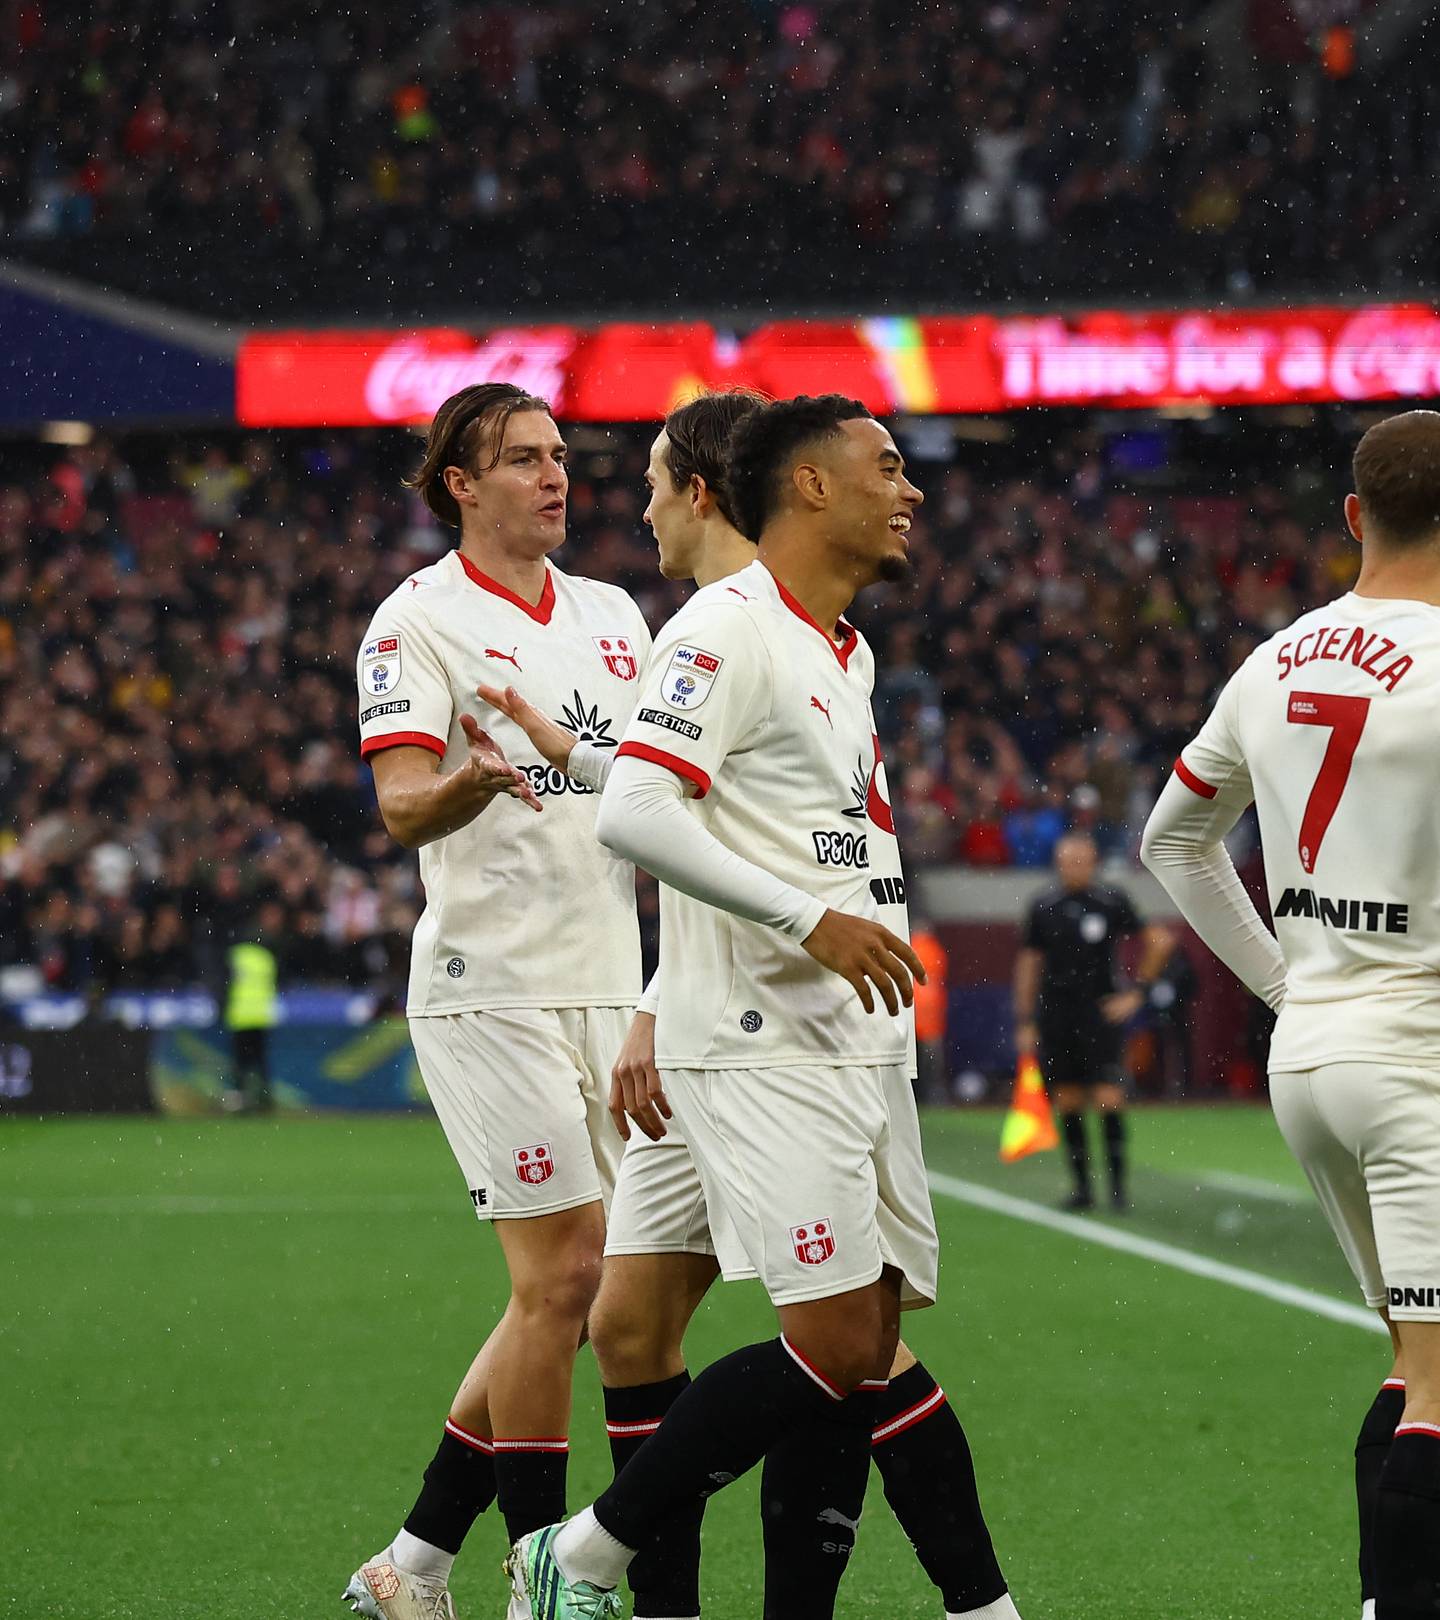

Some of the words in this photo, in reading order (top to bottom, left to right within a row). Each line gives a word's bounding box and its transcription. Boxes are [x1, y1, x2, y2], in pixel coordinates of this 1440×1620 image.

[996, 316, 1168, 396] Time
[1173, 314, 1266, 392] for
[1279, 328, 1326, 388] a
[677, 649, 696, 662] sky
[697, 655, 717, 669] bet
[1277, 626, 1414, 693] SCIENZA
[374, 682, 388, 692] EFL
[671, 693, 687, 706] EFL
[640, 709, 701, 739] TOGETHER
[1287, 691, 1372, 875] 7
[812, 831, 854, 866] P&O
